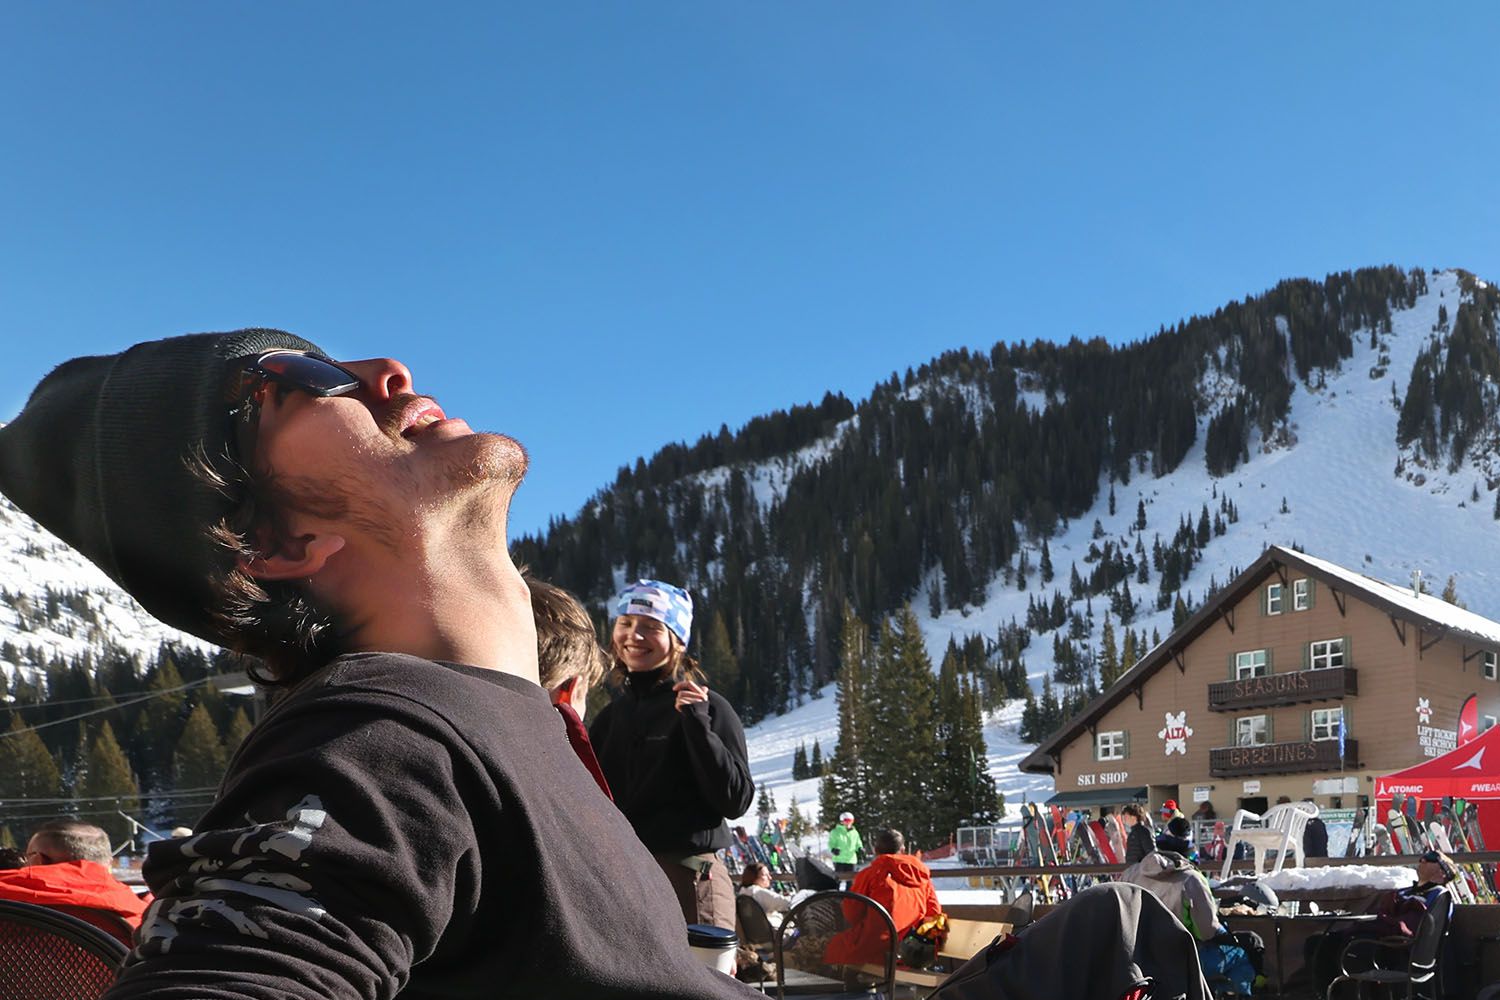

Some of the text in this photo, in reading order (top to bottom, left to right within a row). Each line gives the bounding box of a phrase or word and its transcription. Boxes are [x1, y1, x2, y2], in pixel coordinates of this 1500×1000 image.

[1235, 672, 1308, 698] SEASONS
[1164, 727, 1188, 741] ALTA
[1417, 725, 1433, 737] LIFT
[1420, 736, 1457, 749] SKI SCHOO
[1230, 741, 1317, 766] GREETINGS
[1424, 746, 1436, 757] SKI
[1077, 771, 1128, 786] SKI SHOP
[1387, 784, 1424, 794] ATOMIC
